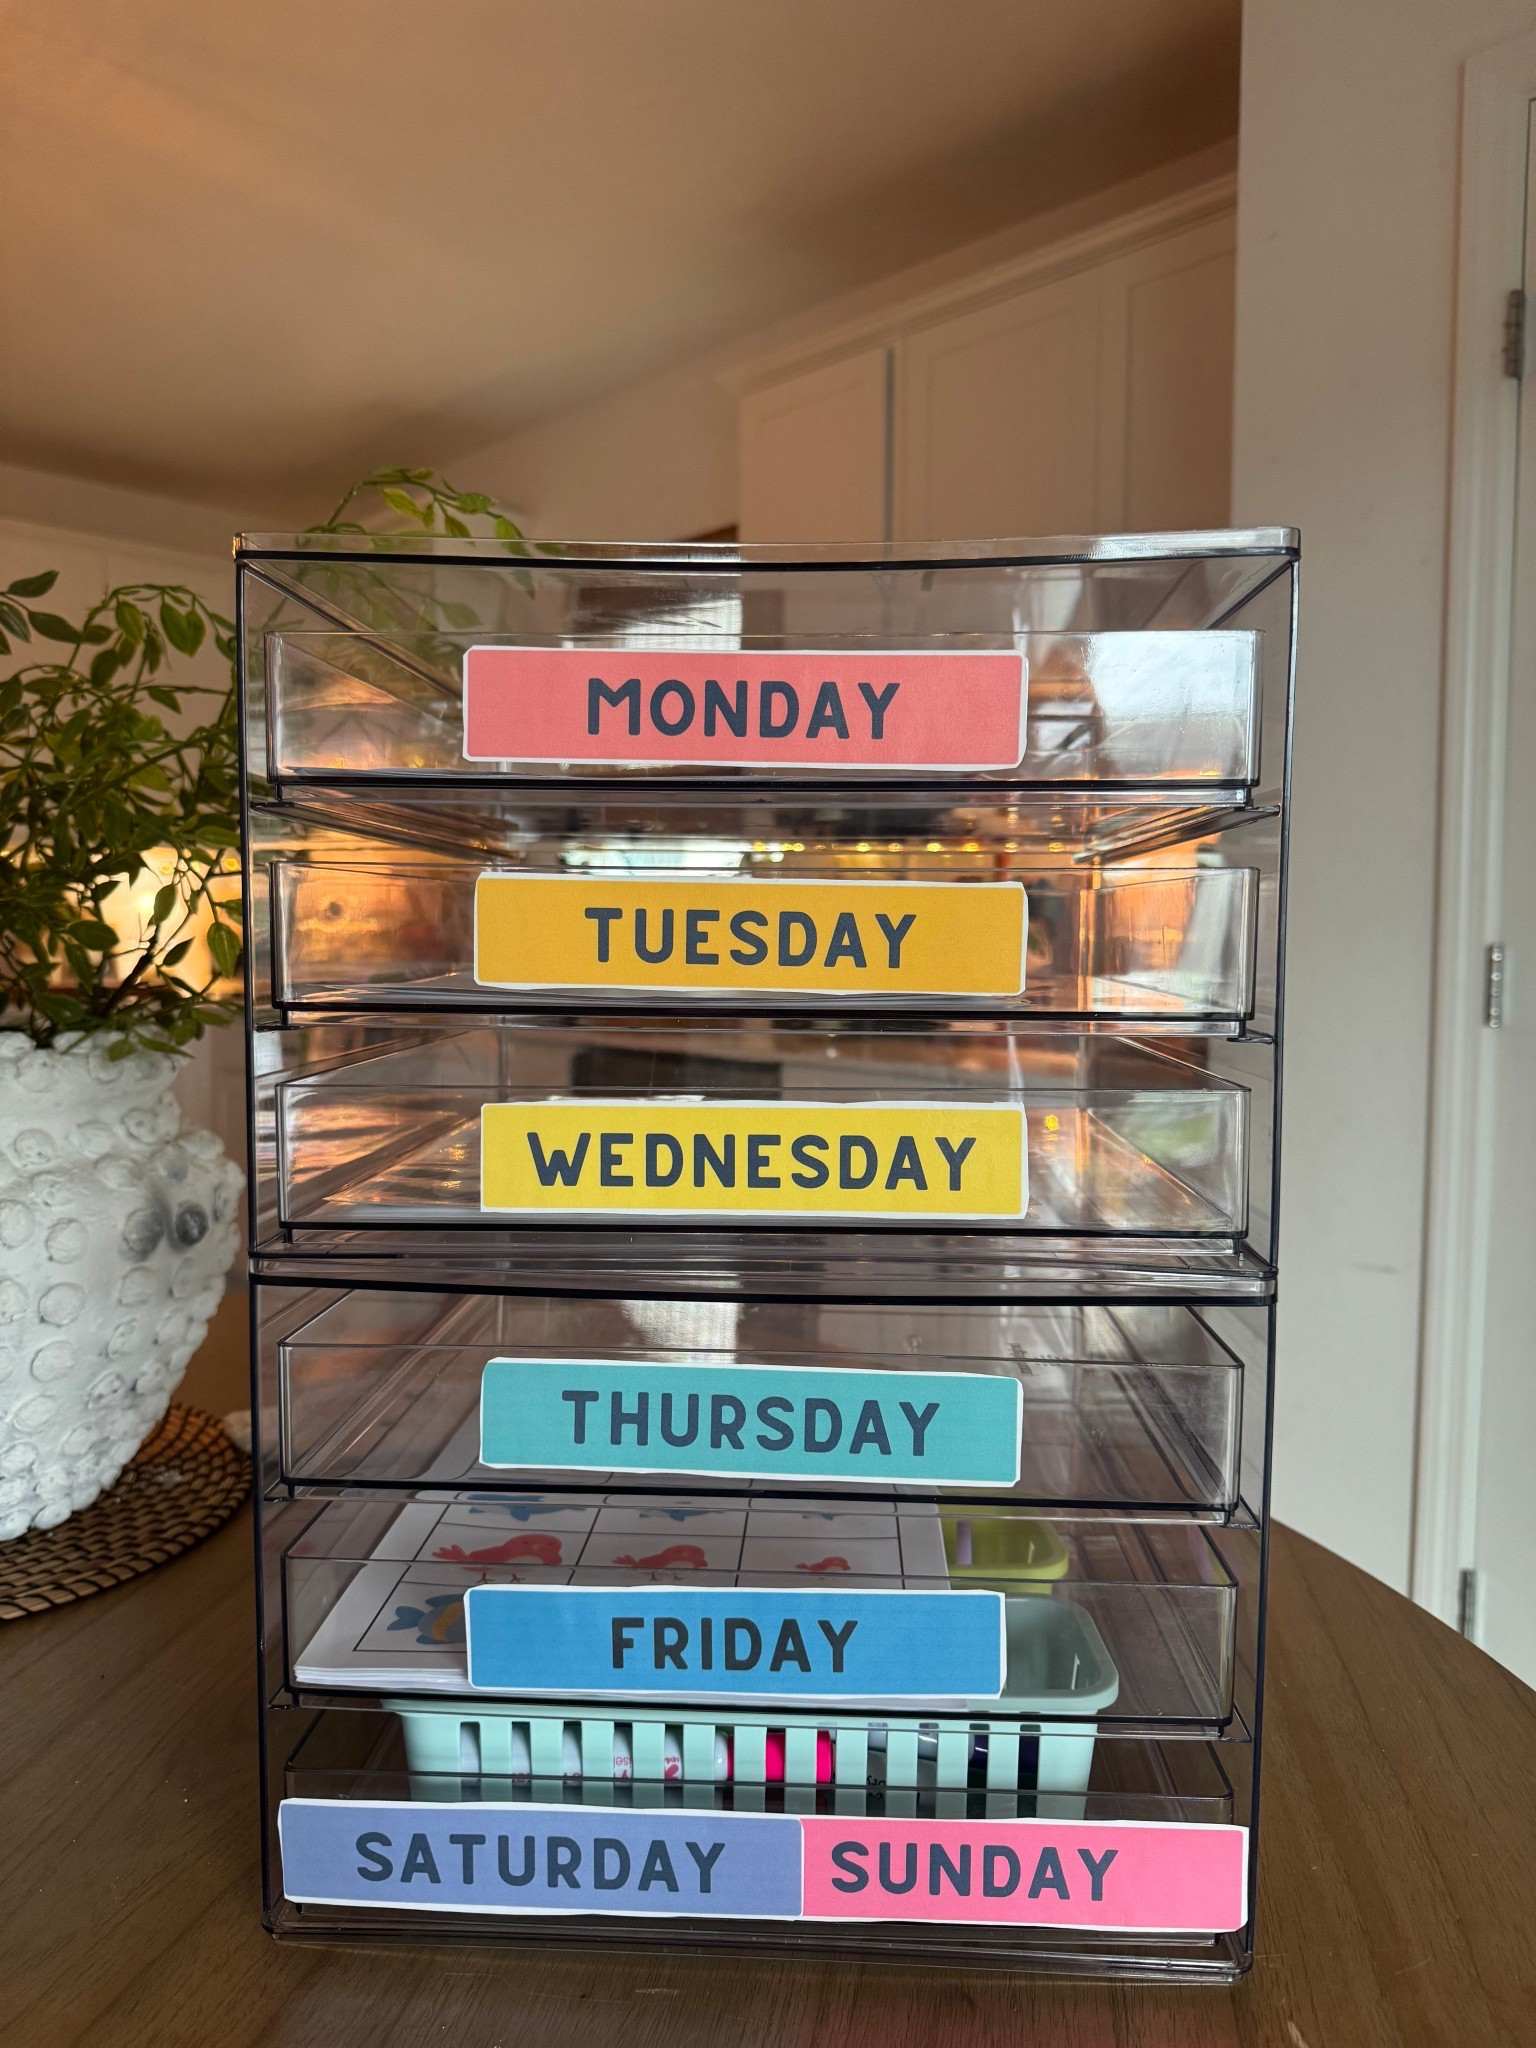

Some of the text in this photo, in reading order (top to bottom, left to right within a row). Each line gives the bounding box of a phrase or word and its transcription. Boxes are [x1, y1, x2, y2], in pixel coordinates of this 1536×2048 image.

[587, 677, 901, 740] MONDAY
[584, 907, 917, 969] TUESDAY
[526, 1131, 977, 1192] WEDNESDAY
[561, 1389, 941, 1457] THURSDAY
[611, 1616, 859, 1673] FRIDAY
[355, 1831, 726, 1894] SATURDAY
[831, 1840, 1119, 1902] SUNDAY
